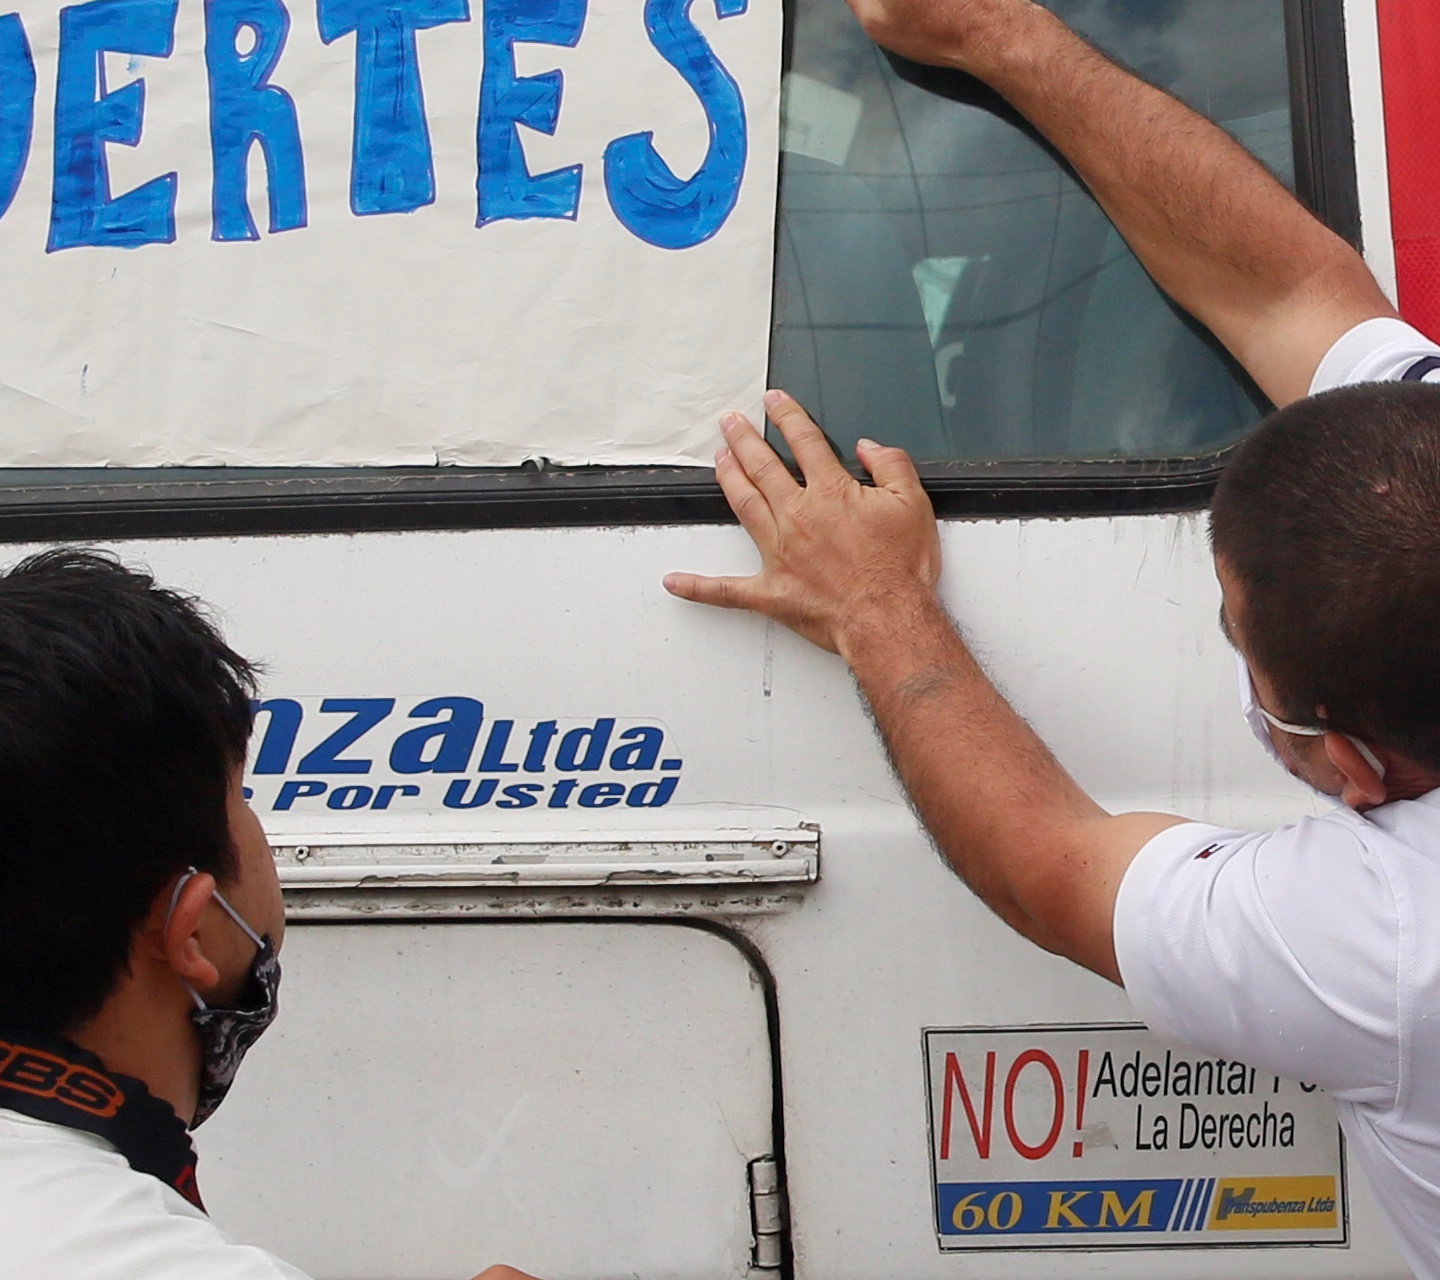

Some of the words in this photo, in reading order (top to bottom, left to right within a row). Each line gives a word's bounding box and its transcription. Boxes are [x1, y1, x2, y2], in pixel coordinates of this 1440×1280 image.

[478, 718, 683, 773] Ltda.
[272, 780, 420, 810] Por
[443, 776, 681, 809] Usted
[940, 1048, 1090, 1161] NO!
[1135, 1103, 1168, 1151] La
[1178, 1102, 1295, 1150] Derecha
[951, 1190, 1024, 1231] 60
[1042, 1188, 1160, 1230] KM
